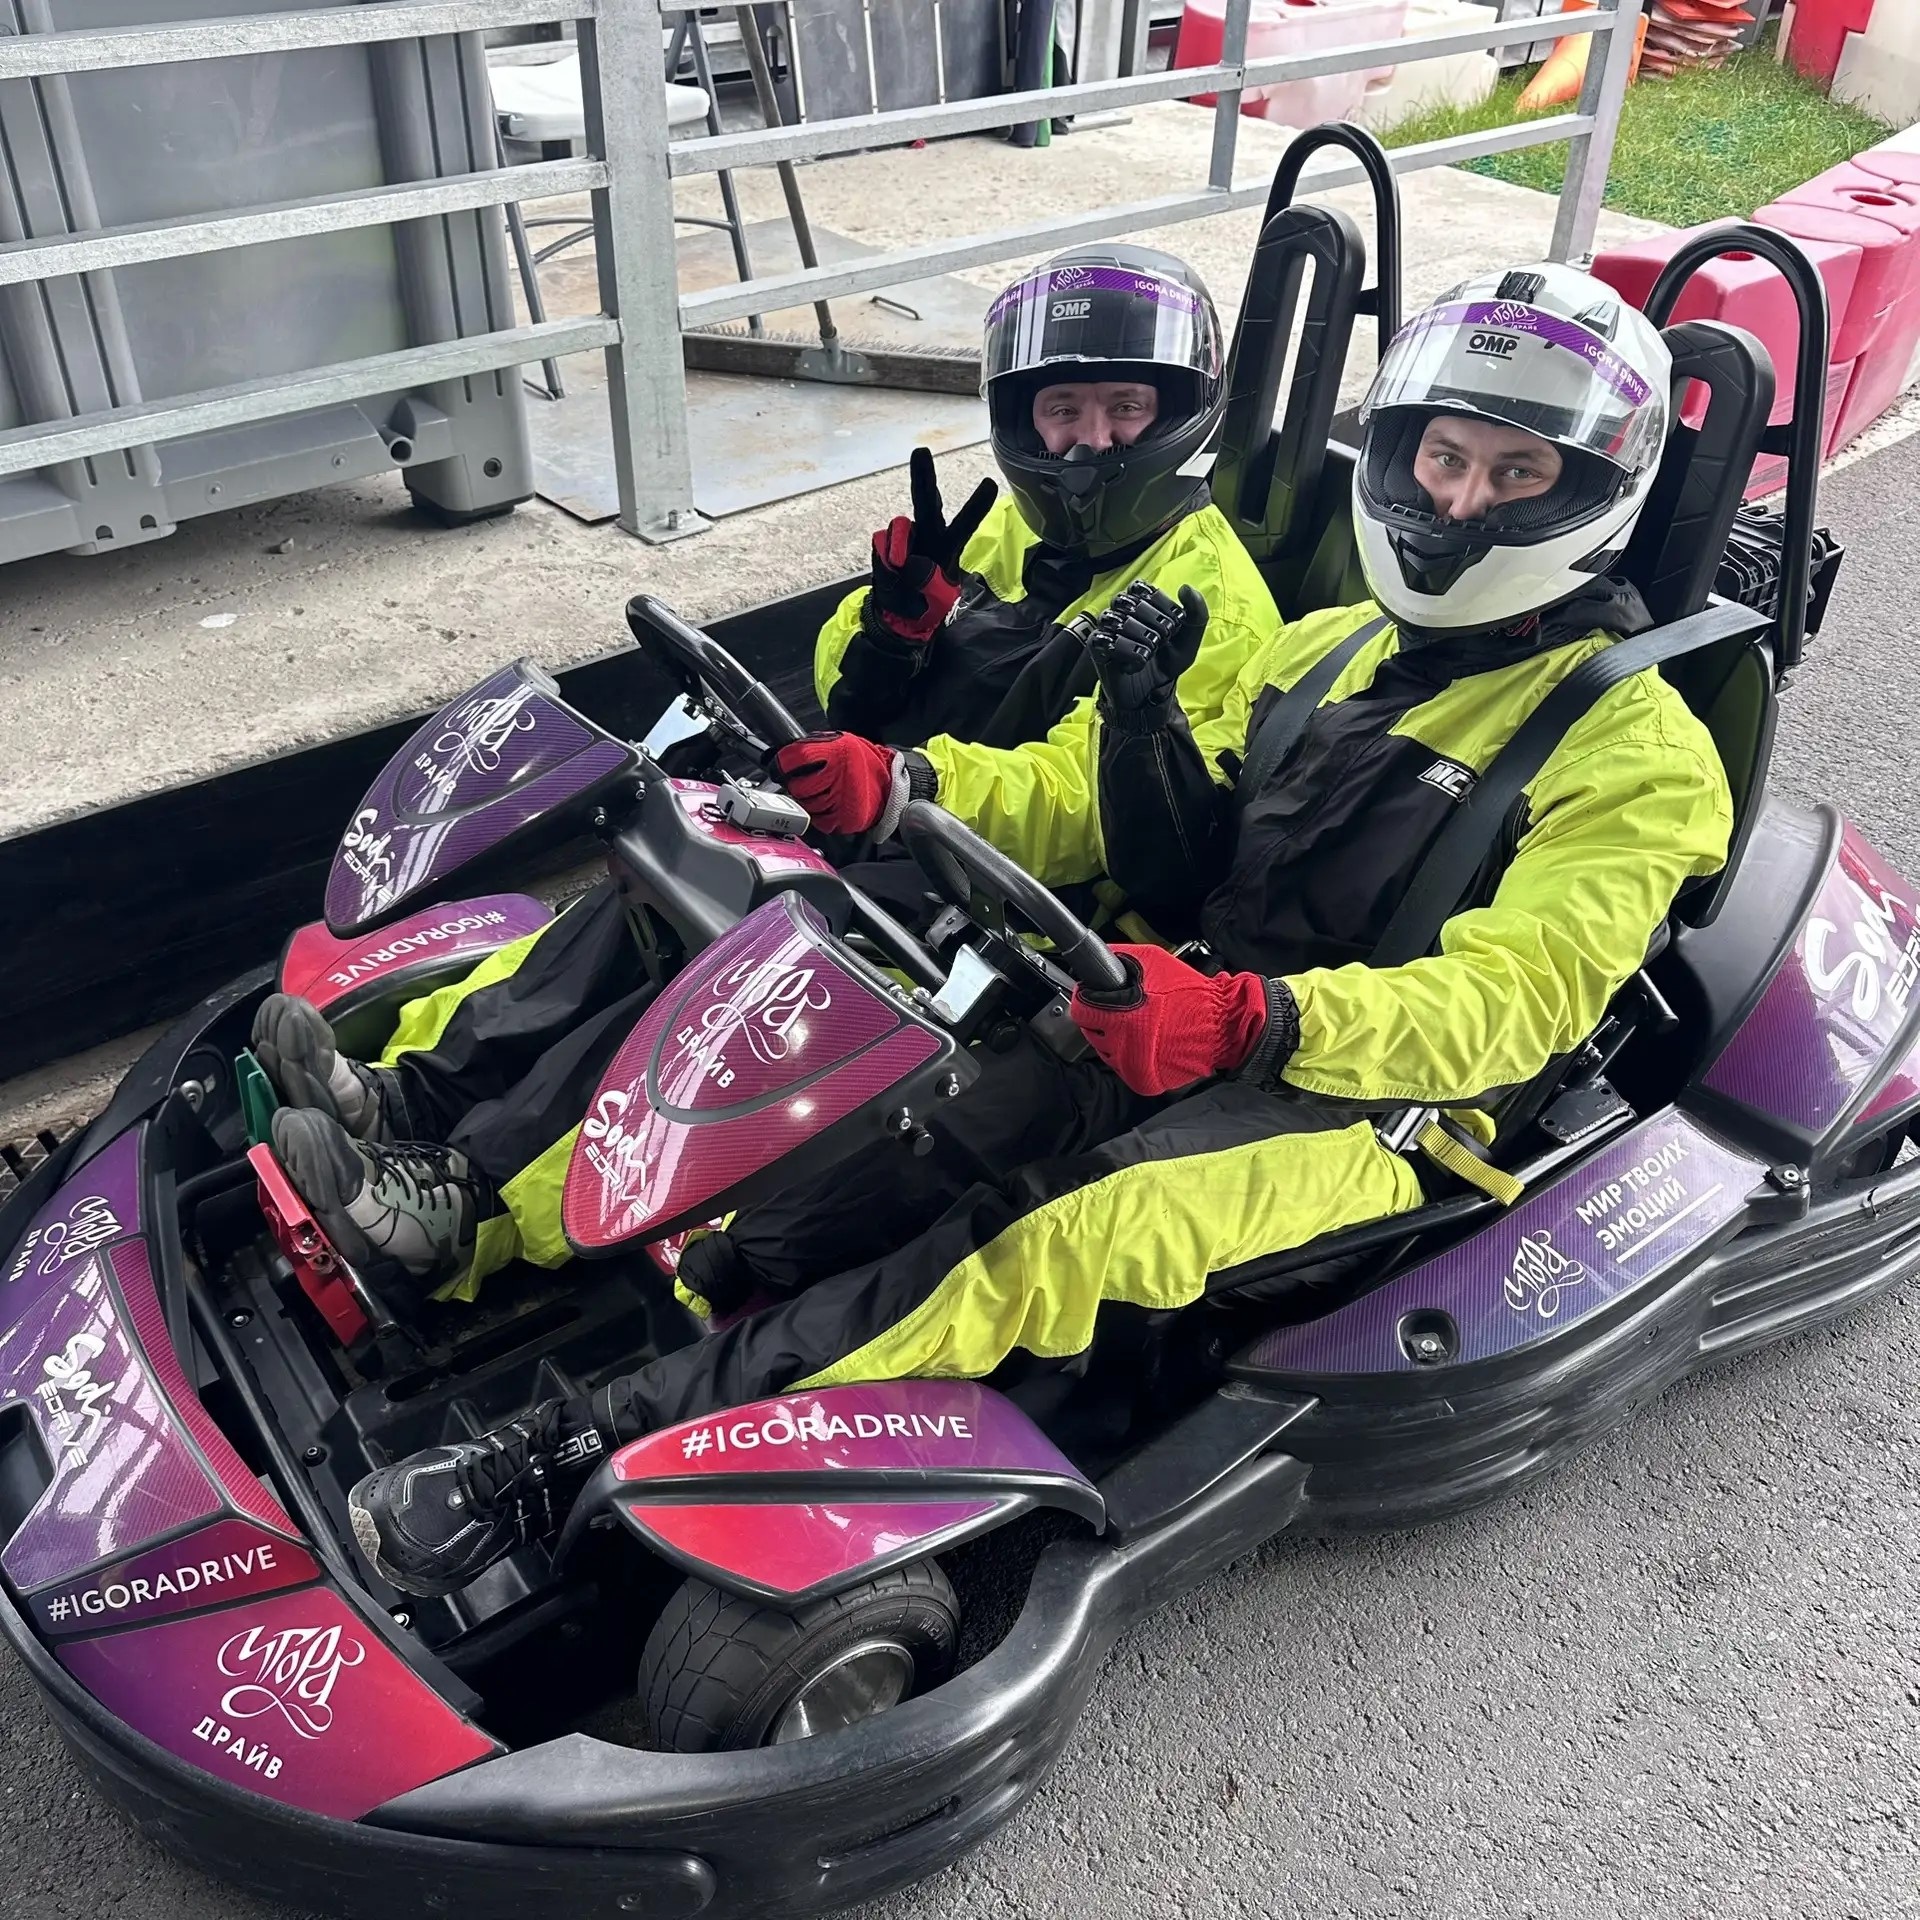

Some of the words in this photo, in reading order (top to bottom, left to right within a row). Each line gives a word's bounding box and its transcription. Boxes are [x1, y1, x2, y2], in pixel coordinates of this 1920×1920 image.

[1051, 302, 1091, 317] OMP
[1134, 280, 1168, 296] IGORA
[1469, 334, 1518, 355] OMP
[1584, 342, 1620, 373] IGORA
[1619, 367, 1644, 399] DRIVE
[414, 752, 457, 795] ДРАЙВ
[327, 910, 507, 987] #IGORADRIVE
[676, 1025, 736, 1089] ДРАЙВ
[1575, 1182, 1622, 1226] МИР
[1619, 1137, 1690, 1193] ТВОИХ
[1595, 1175, 1688, 1251] ЭМОЦИЙ
[680, 1413, 974, 1460] #IGORADRIVE
[47, 1544, 278, 1622] #IGORADRIVE
[191, 1715, 285, 1780] ДРАЙВ
